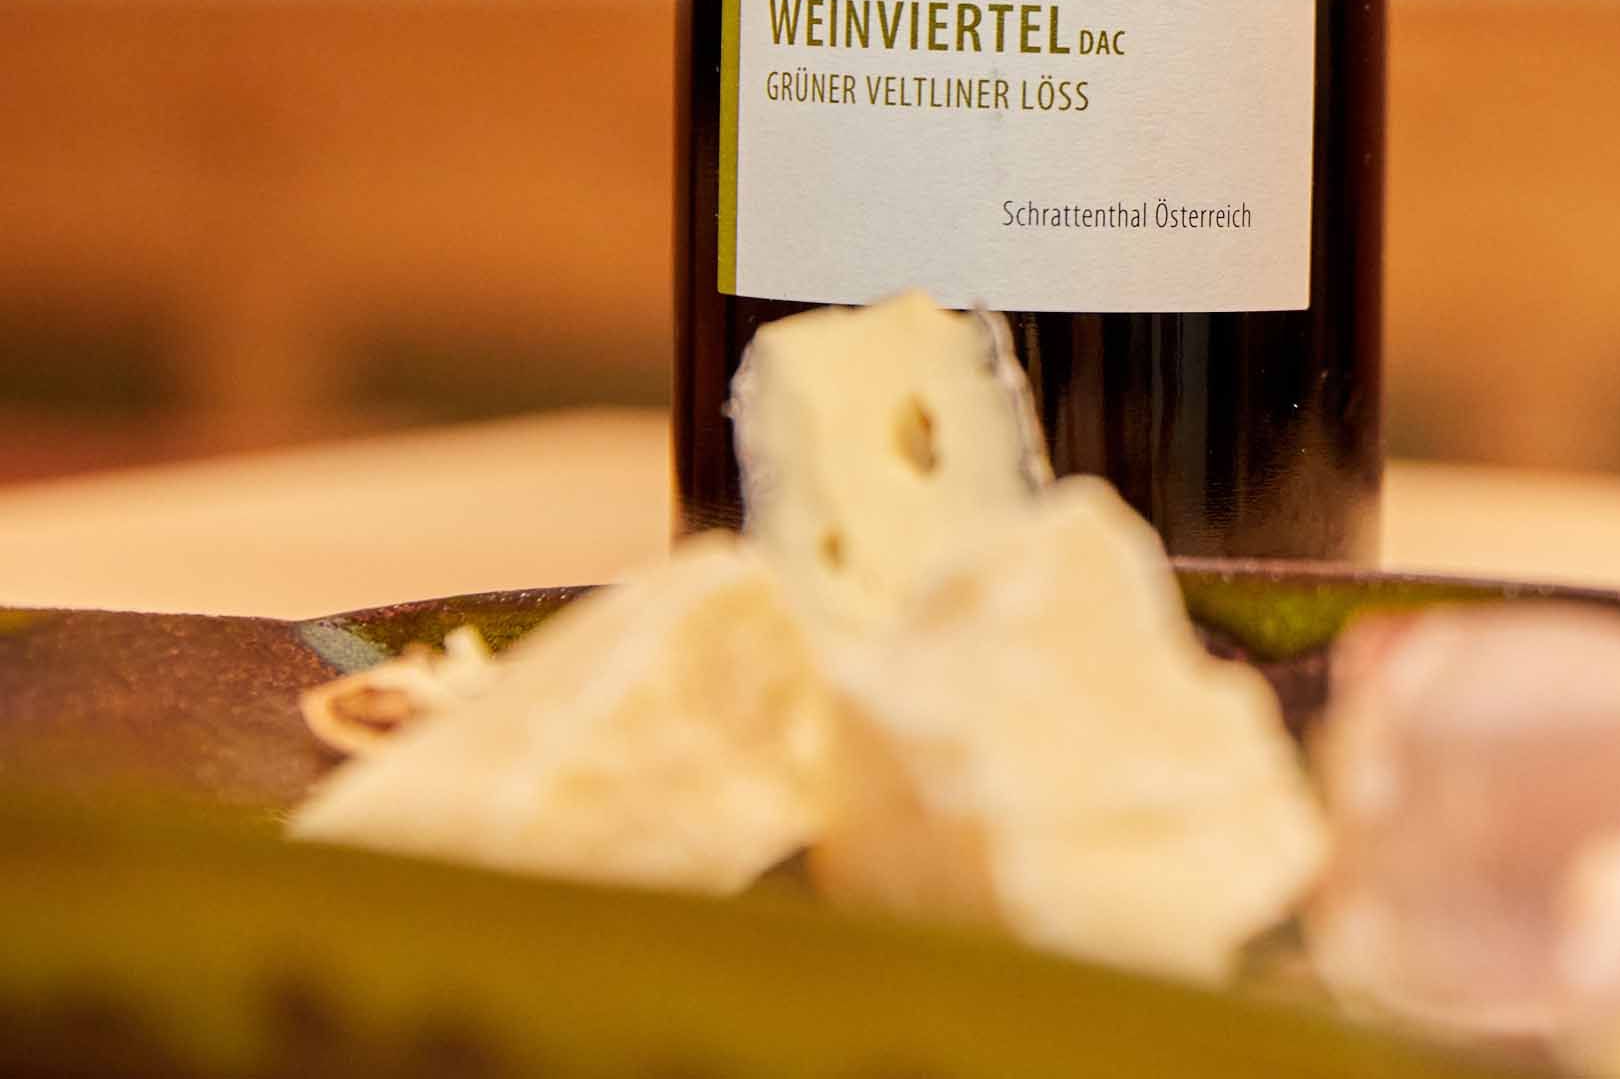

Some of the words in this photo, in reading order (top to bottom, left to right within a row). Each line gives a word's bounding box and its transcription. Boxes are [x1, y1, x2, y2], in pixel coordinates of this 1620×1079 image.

[1079, 30, 1126, 56] DAC
[766, 66, 856, 104] GRÜNER
[866, 75, 1010, 109] VELTLINER
[1021, 75, 1090, 111] LÖSS
[1002, 200, 1147, 228] Schrattenthal
[1155, 198, 1252, 228] Österreich
